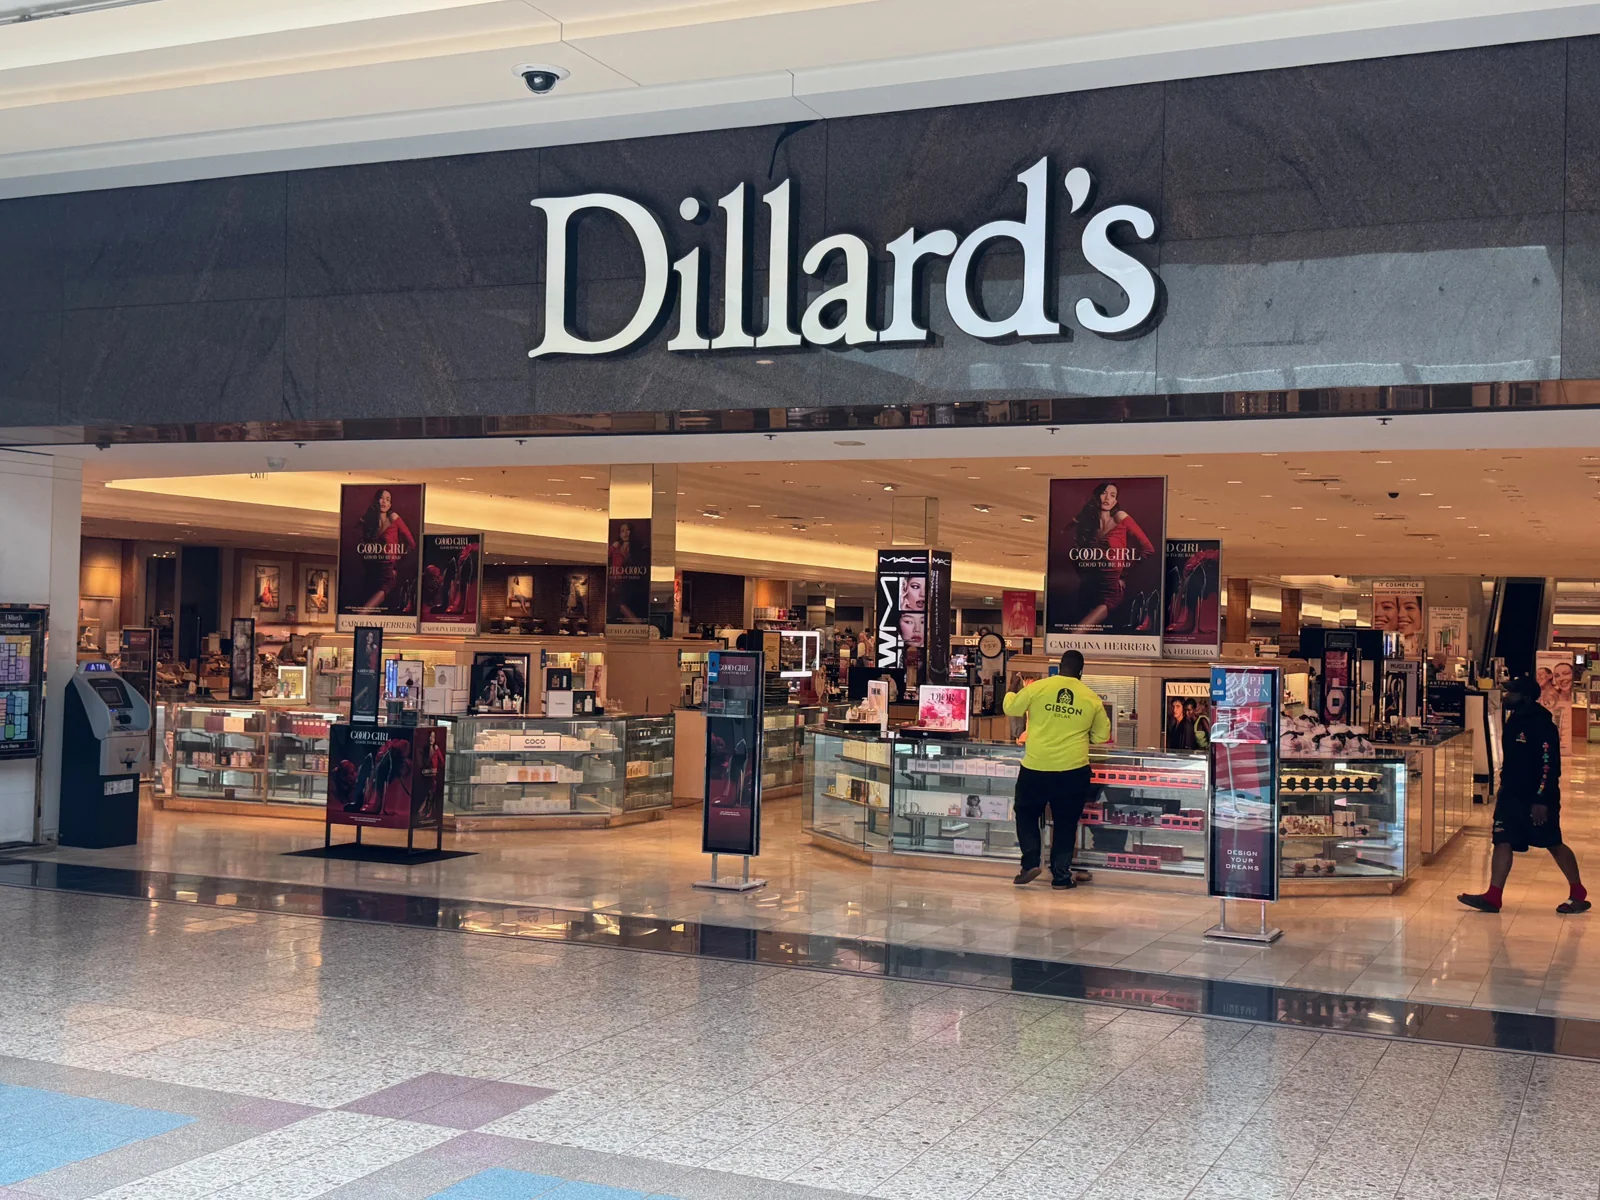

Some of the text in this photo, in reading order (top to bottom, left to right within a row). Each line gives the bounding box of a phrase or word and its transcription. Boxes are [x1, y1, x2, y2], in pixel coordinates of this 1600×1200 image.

[528, 156, 1156, 358] Dillard's
[453, 537, 472, 546] GIRL
[357, 543, 408, 555] GOOD GIRL
[1176, 543, 1203, 553] GIRL
[1069, 547, 1142, 561] GOOD GIRL
[341, 620, 416, 629] CAROLINA HERRERA
[1049, 641, 1101, 650] CAROLINA
[1104, 641, 1157, 652] HERRERA
[1174, 648, 1214, 656] HERRERA
[90, 663, 107, 671] ATM
[735, 664, 751, 672] GIRL
[1167, 684, 1210, 695] VALENTIN
[1044, 703, 1083, 716] GIBSON
[350, 731, 391, 742] GOOD GIRL
[1227, 849, 1258, 857] DESIGN
[1225, 863, 1260, 871] DREAMS
